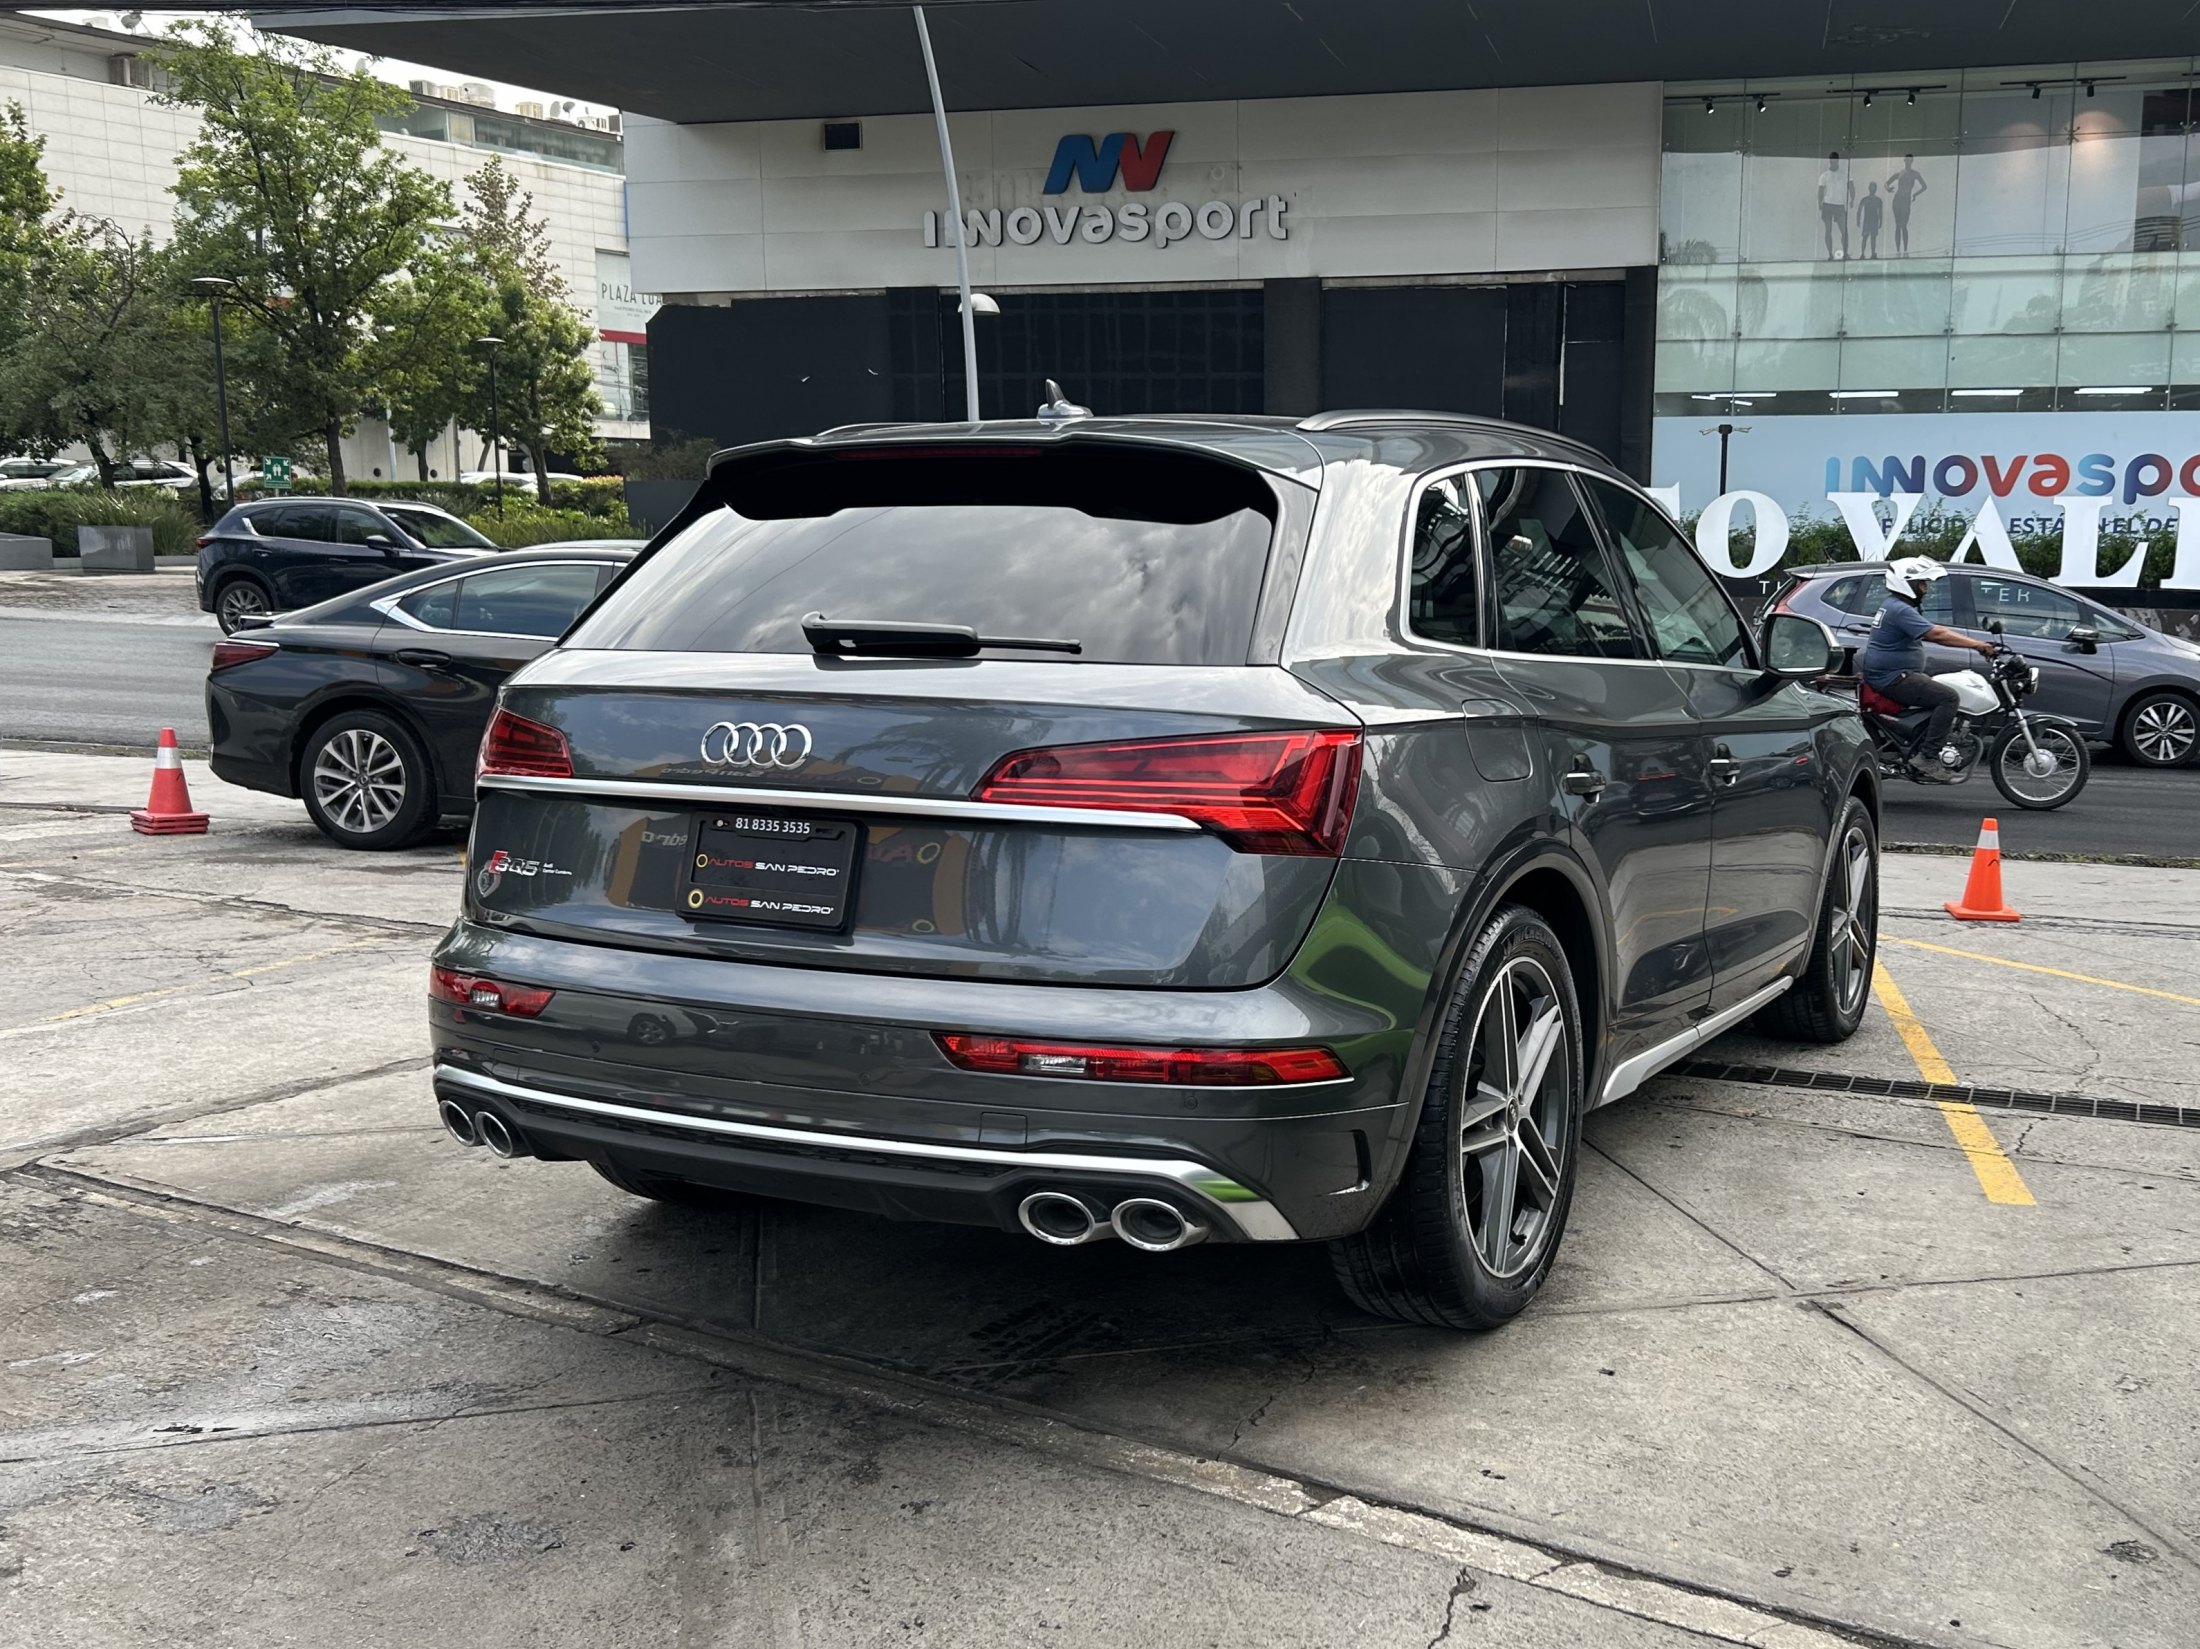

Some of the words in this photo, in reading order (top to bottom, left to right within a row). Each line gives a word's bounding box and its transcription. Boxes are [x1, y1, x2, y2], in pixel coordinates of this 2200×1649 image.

[601, 283, 637, 303] PLAZA
[735, 817, 749, 829] 81
[751, 818, 780, 831] 8335
[782, 821, 811, 834] 3535
[488, 853, 540, 876] SQ5
[708, 858, 753, 868] AUTOS
[754, 862, 786, 872] SAN
[705, 896, 749, 906] AUTOS
[750, 900, 780, 910] SAN
